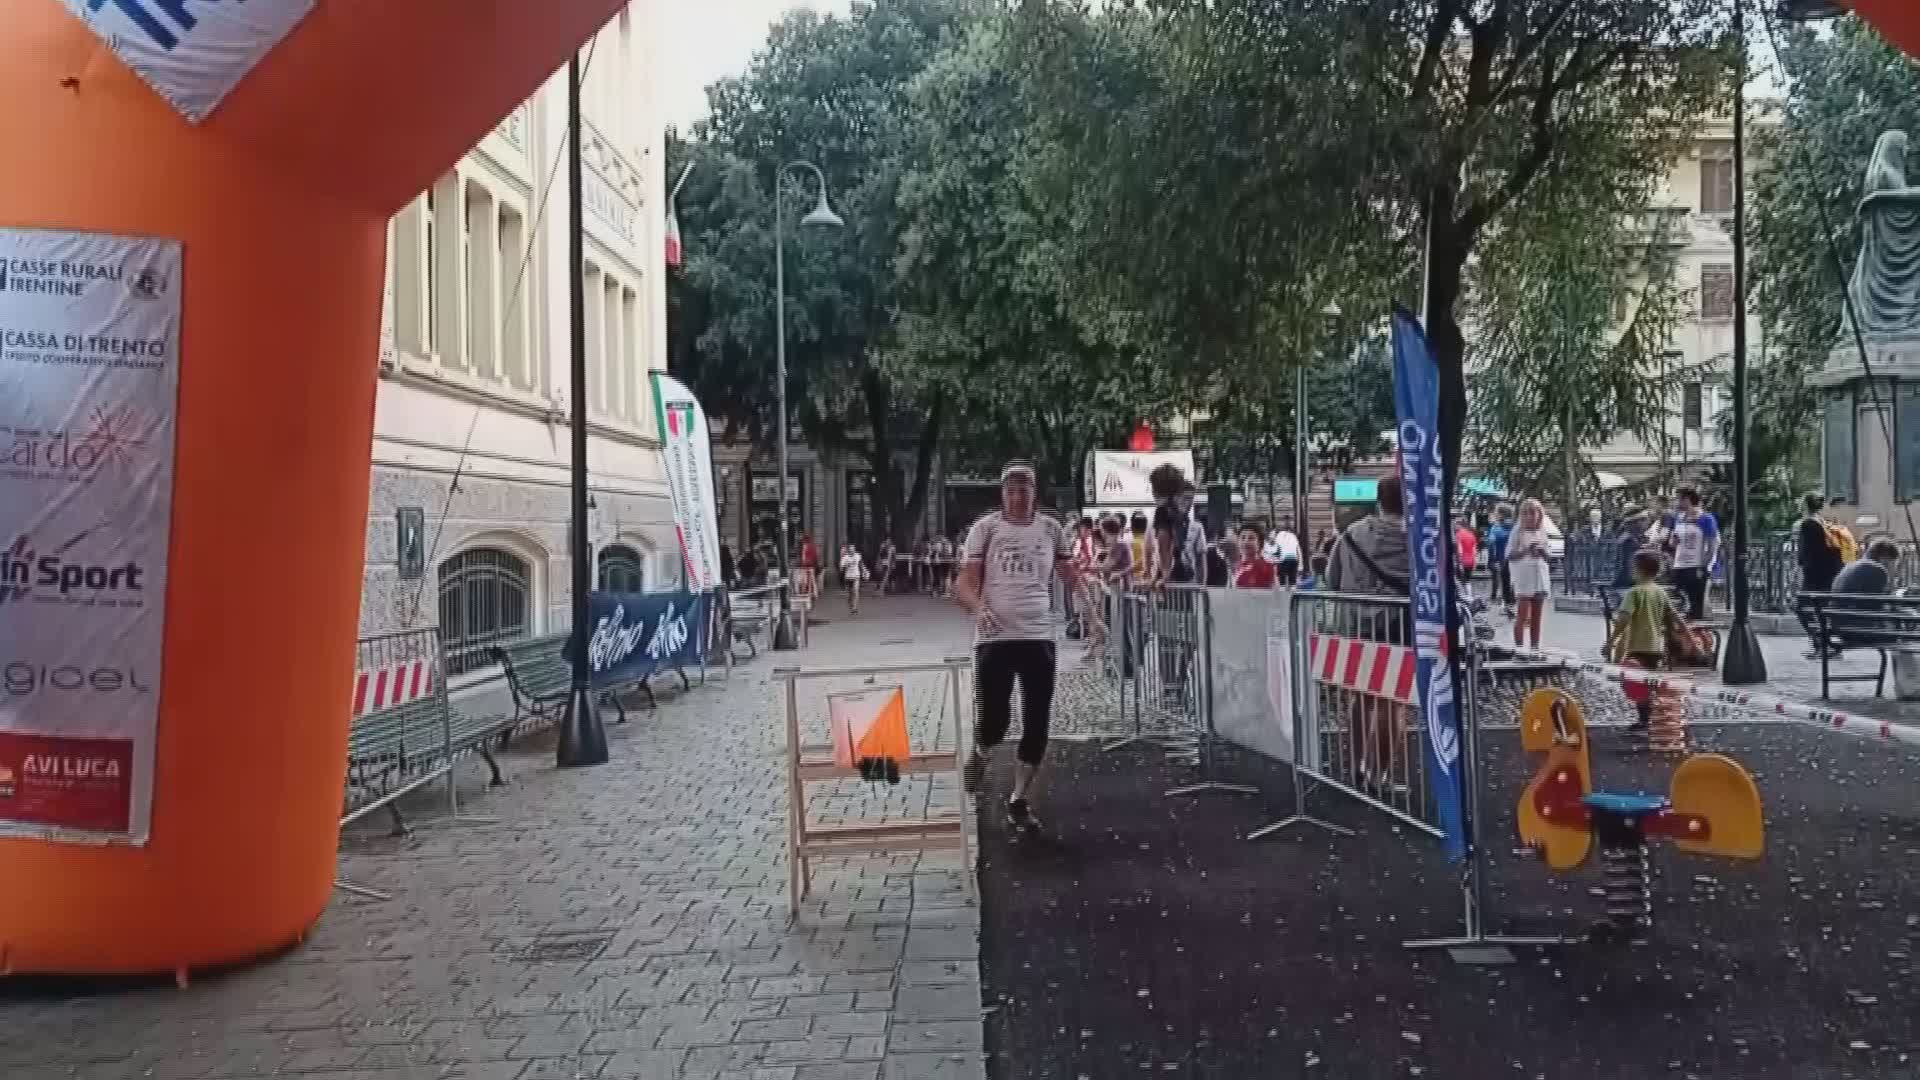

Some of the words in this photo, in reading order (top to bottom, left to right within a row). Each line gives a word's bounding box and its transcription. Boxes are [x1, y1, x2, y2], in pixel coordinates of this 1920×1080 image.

[10, 259, 58, 277] CASSE
[61, 262, 123, 280] RURALI
[10, 277, 84, 296] TRENTINE
[5, 330, 58, 350] CASSA
[64, 335, 83, 352] DI
[87, 336, 165, 356] TRENTO
[37, 556, 143, 593] Sport
